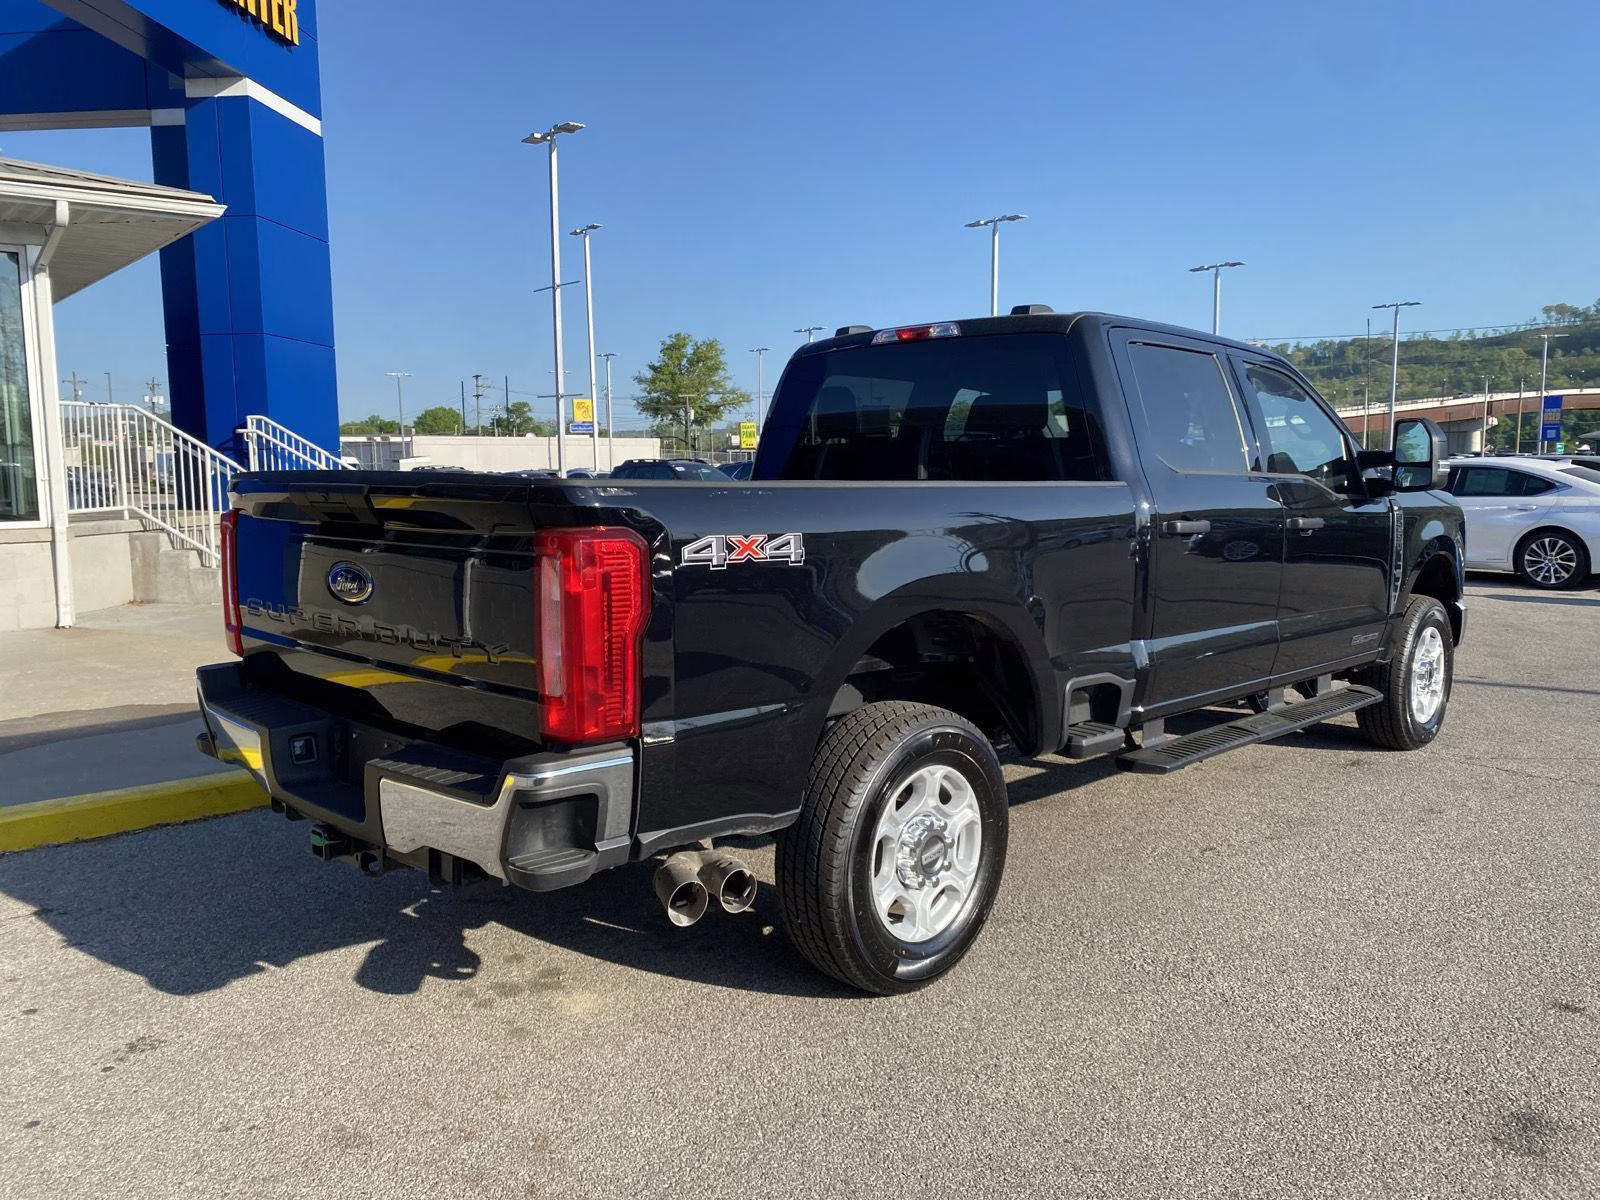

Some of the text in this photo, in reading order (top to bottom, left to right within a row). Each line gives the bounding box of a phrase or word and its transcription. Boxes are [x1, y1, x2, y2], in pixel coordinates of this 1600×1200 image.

[336, 571, 362, 594] Ford
[246, 597, 510, 664] SUPER DUTY
